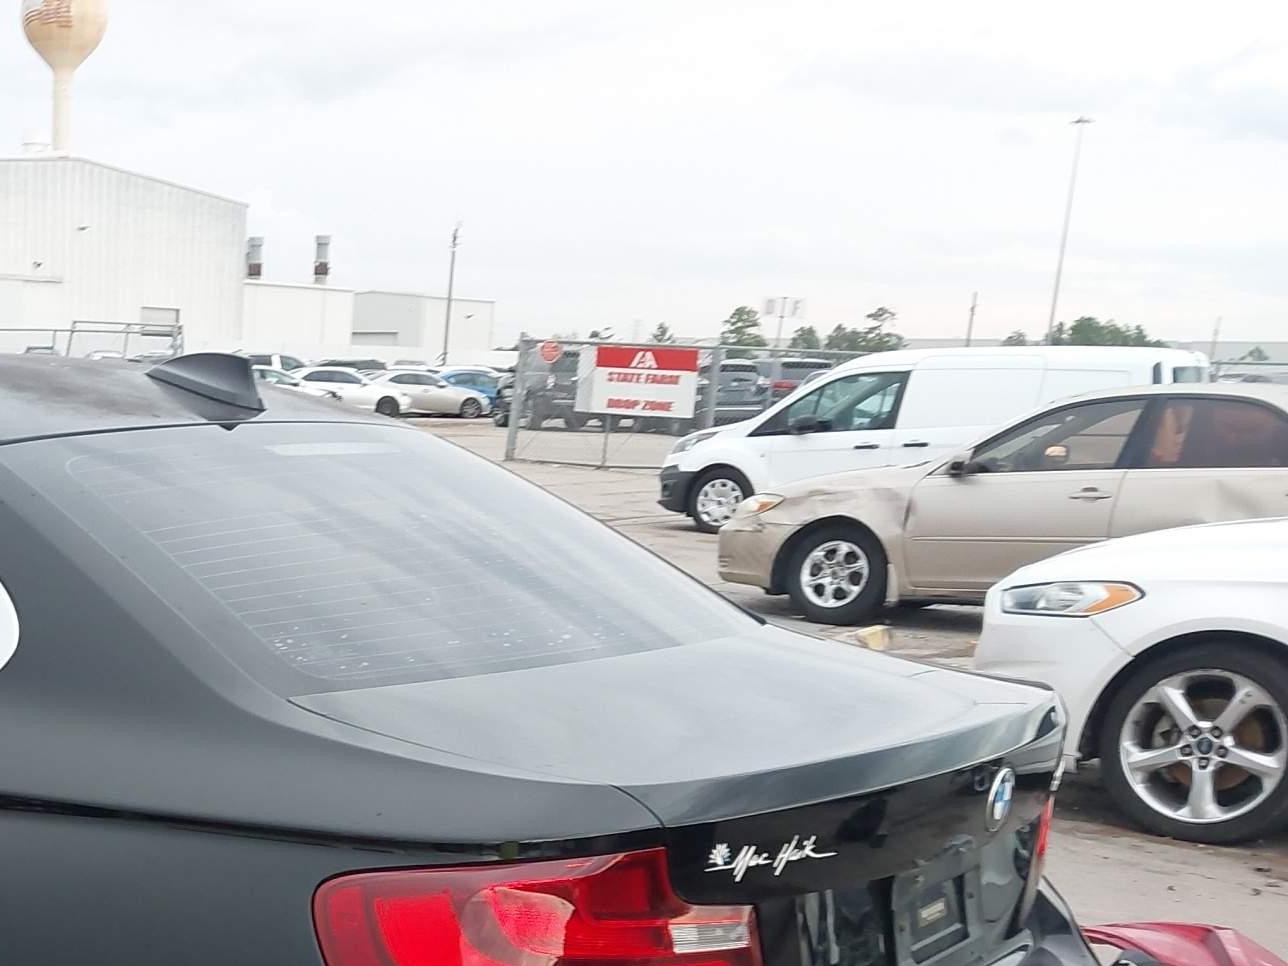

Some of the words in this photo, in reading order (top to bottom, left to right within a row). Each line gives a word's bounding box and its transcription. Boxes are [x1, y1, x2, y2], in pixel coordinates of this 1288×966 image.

[607, 371, 644, 383] STATE
[645, 373, 681, 385] FARM
[606, 398, 640, 410] DROP
[641, 400, 676, 411] ZONE
